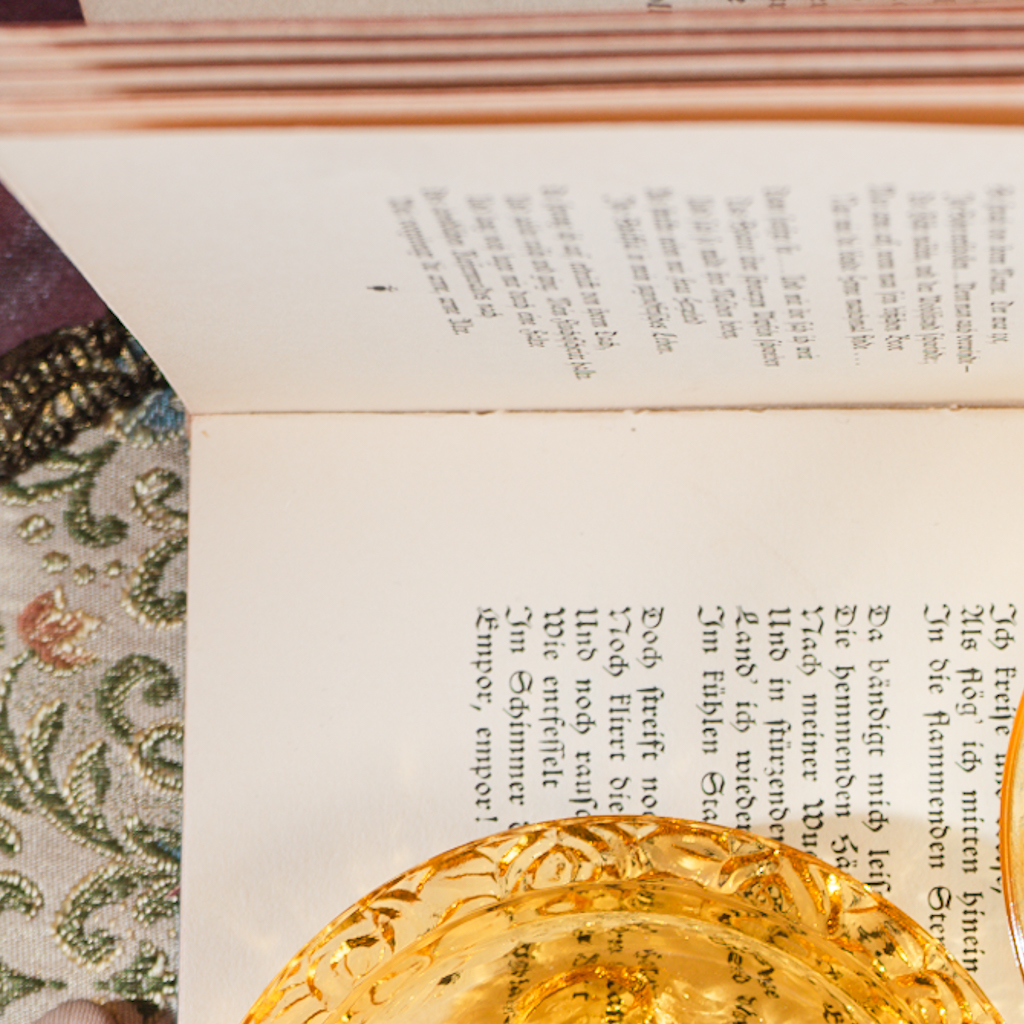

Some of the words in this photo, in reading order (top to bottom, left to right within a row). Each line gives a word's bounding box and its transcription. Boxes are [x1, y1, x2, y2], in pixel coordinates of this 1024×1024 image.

[505, 605, 533, 655] Im
[542, 606, 566, 661] Wie
[574, 607, 598, 662] Und
[602, 606, 632, 678] Noch
[636, 606, 665, 669] Doch
[697, 605, 726, 655] Im
[767, 607, 792, 662] Und
[796, 605, 825, 677] Nach
[834, 604, 858, 649] Die
[867, 604, 891, 643] Da
[923, 603, 951, 644] In
[960, 604, 985, 651] Als
[469, 606, 499, 712] Empor,
[928, 658, 951, 696] die
[569, 678, 597, 735] noch
[695, 670, 726, 756] kühlen
[730, 701, 758, 733] ich
[768, 677, 792, 703] in
[861, 659, 891, 758] bändigt
[502, 669, 534, 806] Schimmer
[608, 694, 633, 762] klirrt
[800, 693, 826, 782] meiner
[828, 664, 857, 819] hemmenden
[469, 726, 499, 823] empor!
[955, 741, 985, 774] ich
[608, 776, 632, 814] die
[701, 771, 726, 824] Sta
[861, 773, 891, 833] mich
[922, 710, 951, 869] flammenden
[961, 789, 986, 875] mitten
[956, 890, 986, 973] hinein
